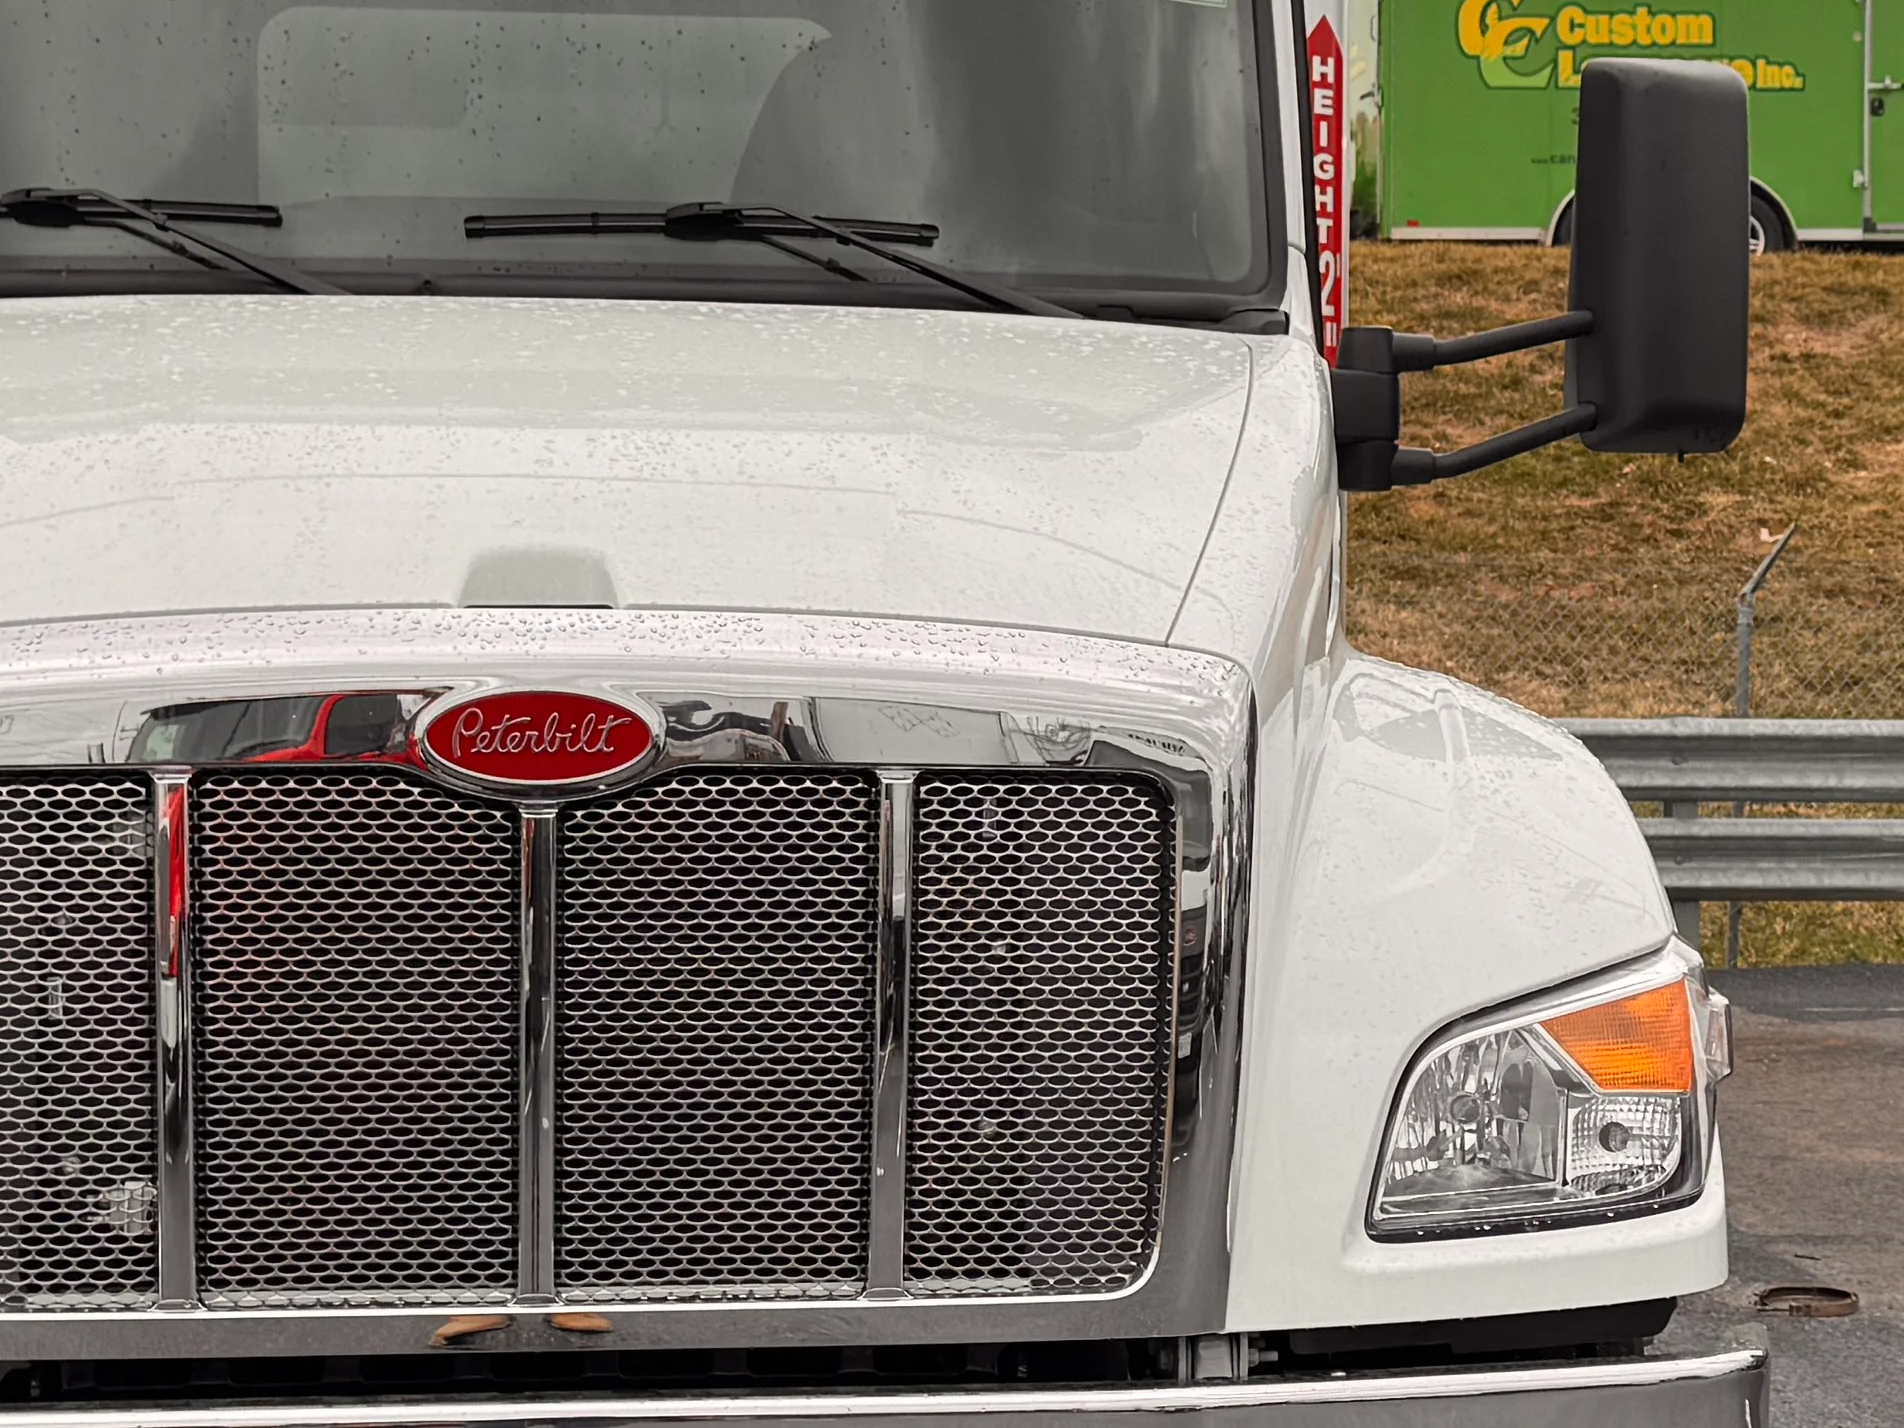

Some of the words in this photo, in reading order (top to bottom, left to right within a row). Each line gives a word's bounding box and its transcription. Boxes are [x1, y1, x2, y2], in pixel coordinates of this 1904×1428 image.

[1555, 4, 1715, 47] Custom
[1755, 59, 1804, 90] Inc.
[1311, 55, 1335, 244] HEIGHT
[451, 707, 633, 759] Peterbilt
